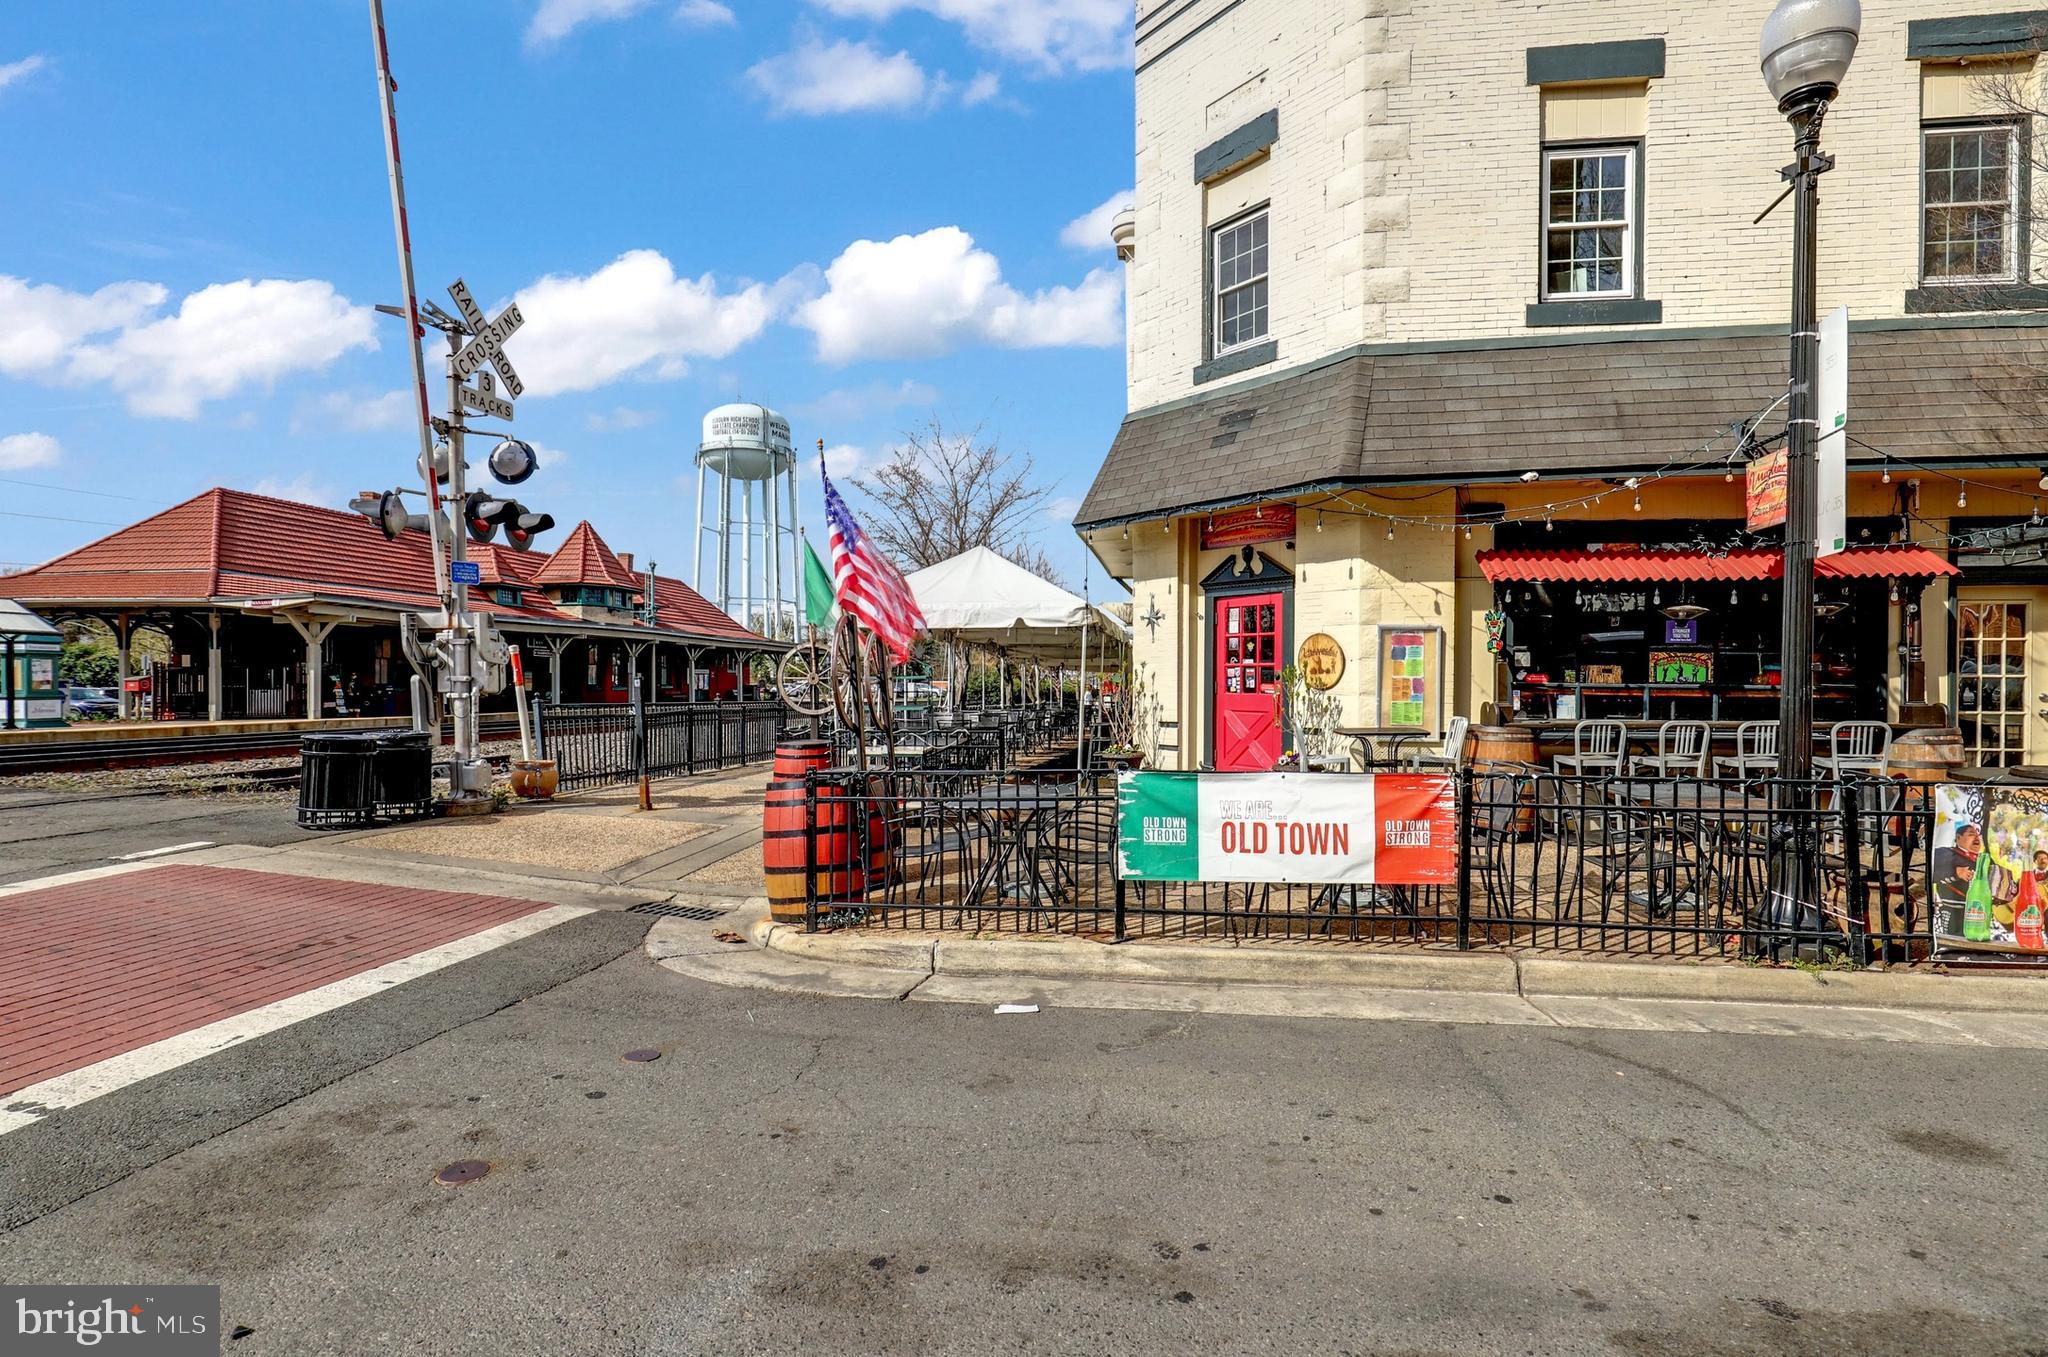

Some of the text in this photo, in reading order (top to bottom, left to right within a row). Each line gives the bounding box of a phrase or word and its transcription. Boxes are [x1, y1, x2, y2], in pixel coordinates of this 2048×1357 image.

[453, 280, 482, 334] RAIL
[458, 307, 522, 375] CROSSING
[494, 351, 523, 396] ROAD
[483, 377, 491, 392] 3
[462, 390, 511, 417] TRACKS
[1219, 800, 1242, 820] WE
[1143, 816, 1187, 828] OLD TOWN
[1385, 819, 1430, 832] OLD TOWN
[1144, 829, 1186, 842] STRONG
[1221, 821, 1349, 856] OLD TOWN
[1386, 832, 1429, 845] STRONG
